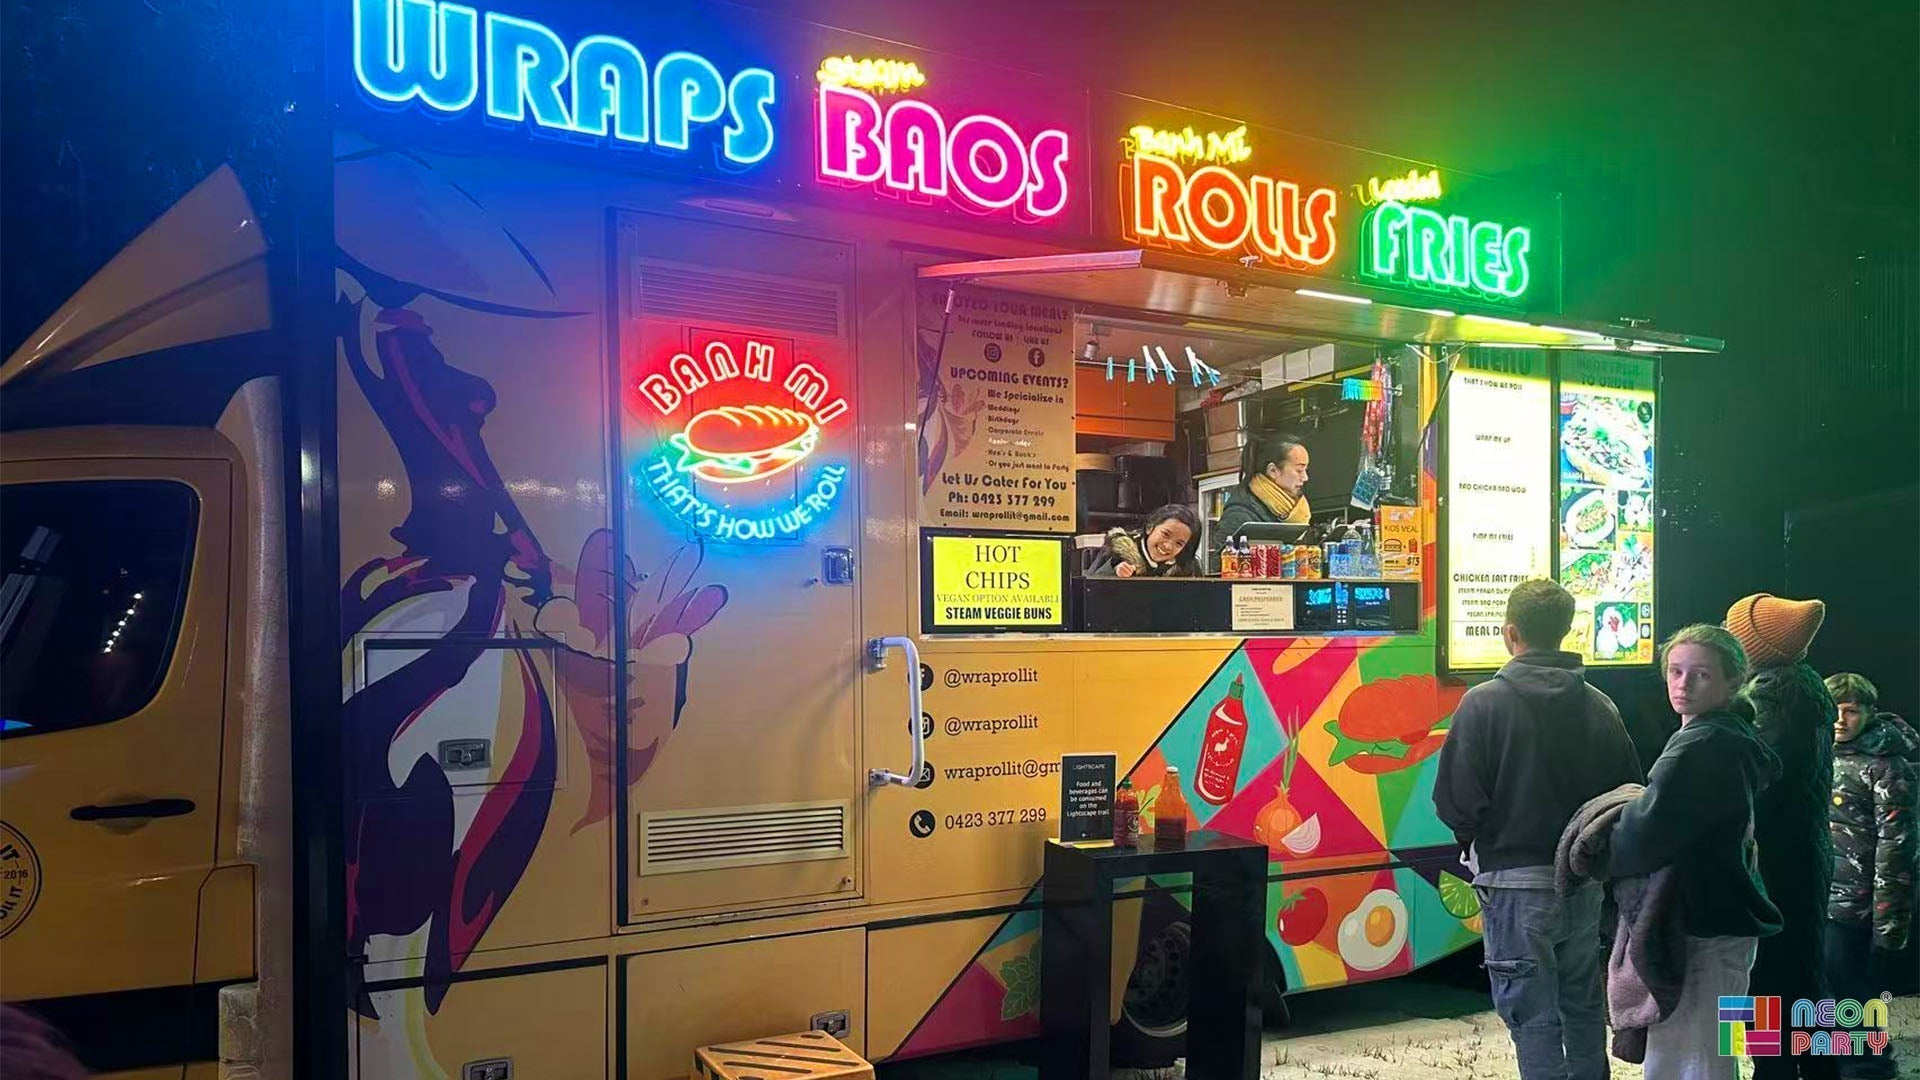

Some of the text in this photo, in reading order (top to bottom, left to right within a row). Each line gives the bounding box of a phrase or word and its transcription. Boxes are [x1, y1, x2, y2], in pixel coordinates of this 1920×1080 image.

[353, 0, 775, 164] WRAPS
[818, 83, 1069, 218] BAOS
[1132, 152, 1337, 267] ROLLS
[1372, 201, 1531, 299] FRIES
[971, 329, 1001, 340] FOLLOW
[638, 340, 849, 426] BANH MI
[950, 365, 1069, 389] UPCOMING EVENTS?
[987, 388, 1002, 399] We
[1055, 395, 1064, 404] in
[987, 404, 1020, 414] Weddings
[987, 415, 1020, 426] Birthdays
[987, 459, 998, 468] Or
[998, 461, 1011, 470] you
[1011, 461, 1025, 471] just
[1043, 463, 1051, 472] to
[1051, 463, 1070, 474] Party
[942, 472, 1067, 491] Let Us Cater For You
[648, 456, 847, 540] THAT'S HOW WE ROLL
[948, 491, 1056, 508] Ph: 0423 377 299
[939, 508, 1070, 523] Email: wraprollit@gmail.com
[1384, 524, 1419, 534] KIDS MEAL
[976, 545, 1022, 563] HOT
[965, 571, 1030, 590] CHIPS
[1453, 573, 1490, 583] CHICKEN
[1491, 573, 1508, 584] SALT
[936, 594, 970, 604] VEGAN
[971, 594, 1009, 604] OPTION
[945, 606, 1052, 620] STEAM VEGGIE BUNS
[1465, 624, 1490, 637] MEAL
[944, 668, 1038, 688] @wraprollit
[944, 715, 1039, 736] @wraprollit
[1068, 788, 1098, 796] beverages
[1076, 780, 1091, 788] Food
[1078, 794, 1107, 802] consumed
[945, 807, 1047, 829] 0423 377 299
[3, 869, 29, 880] 2016
